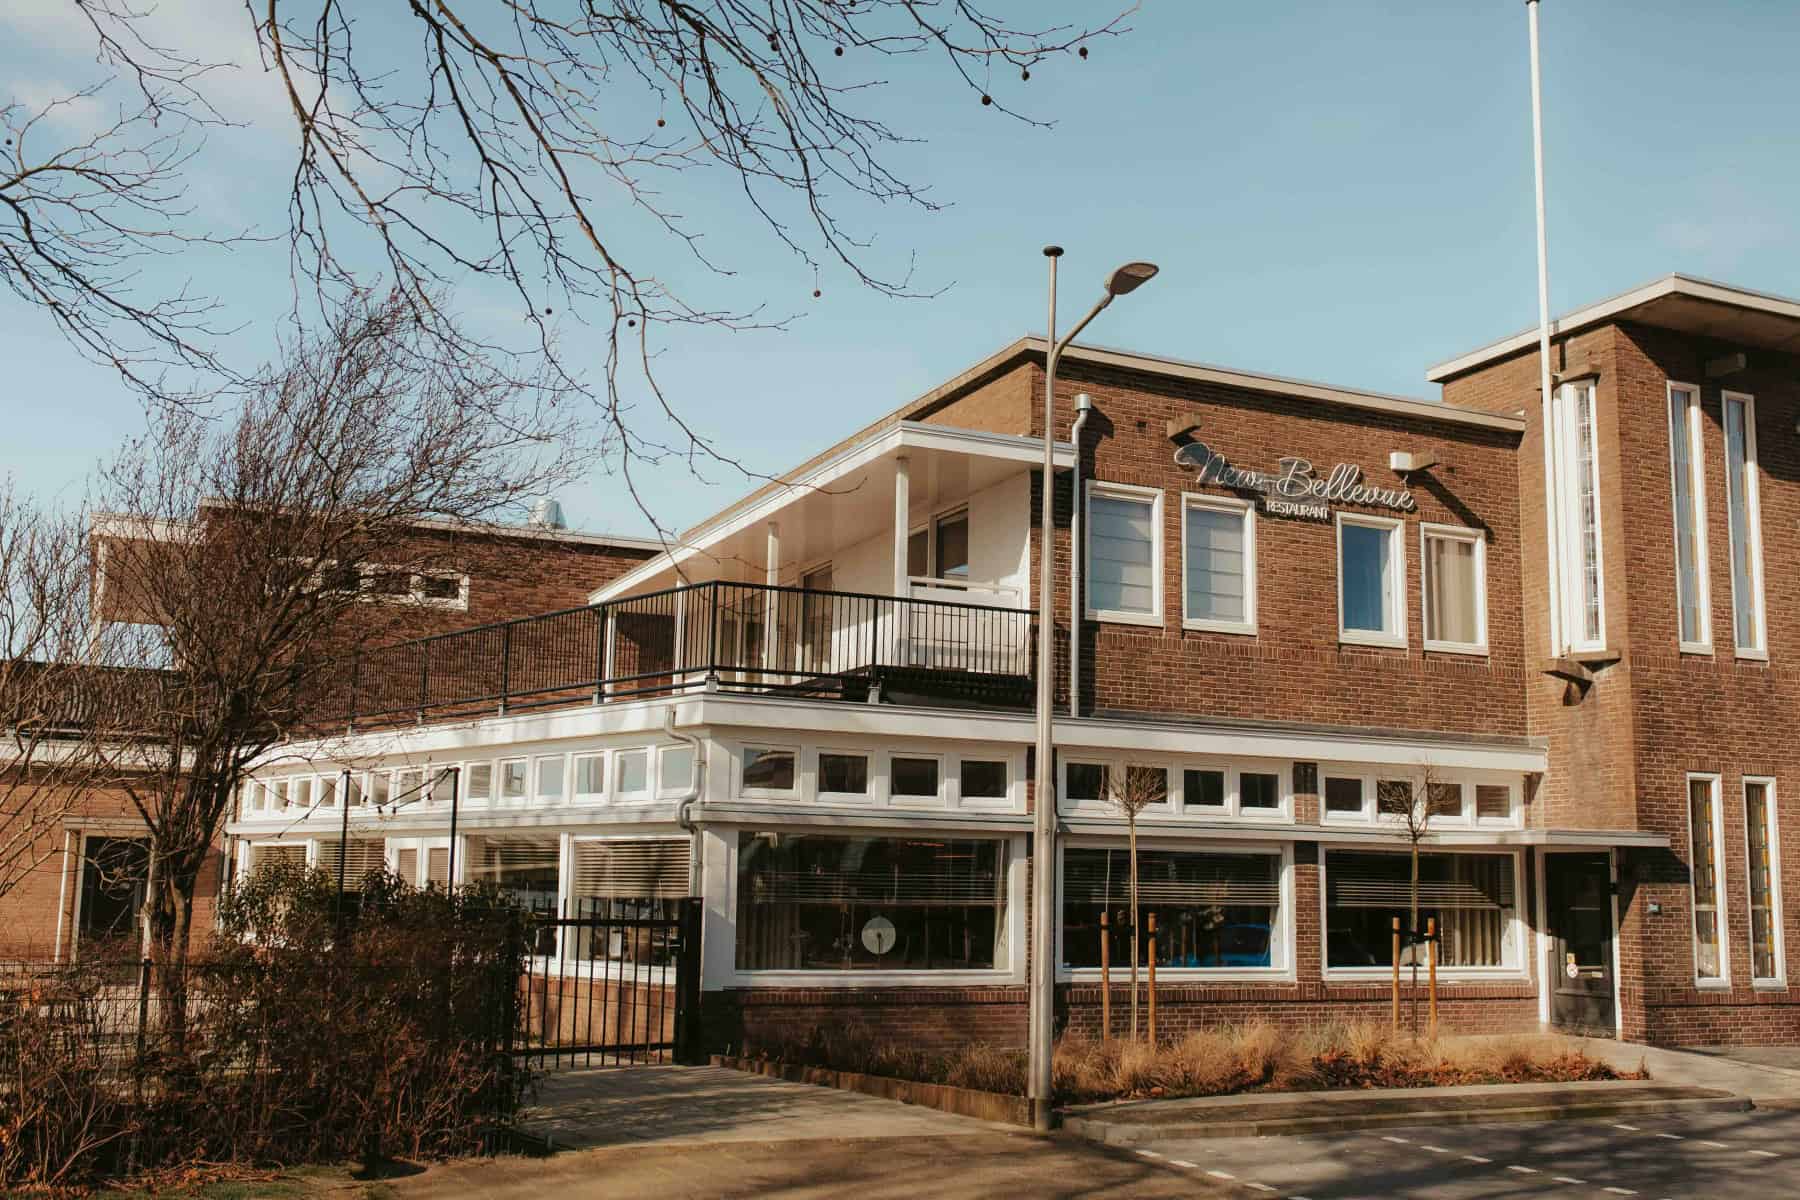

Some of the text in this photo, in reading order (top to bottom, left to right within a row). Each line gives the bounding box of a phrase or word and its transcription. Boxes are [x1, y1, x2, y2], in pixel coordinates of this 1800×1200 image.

[1174, 442, 1415, 509] New Bellevue
[1266, 500, 1329, 519] RESTAURANT
